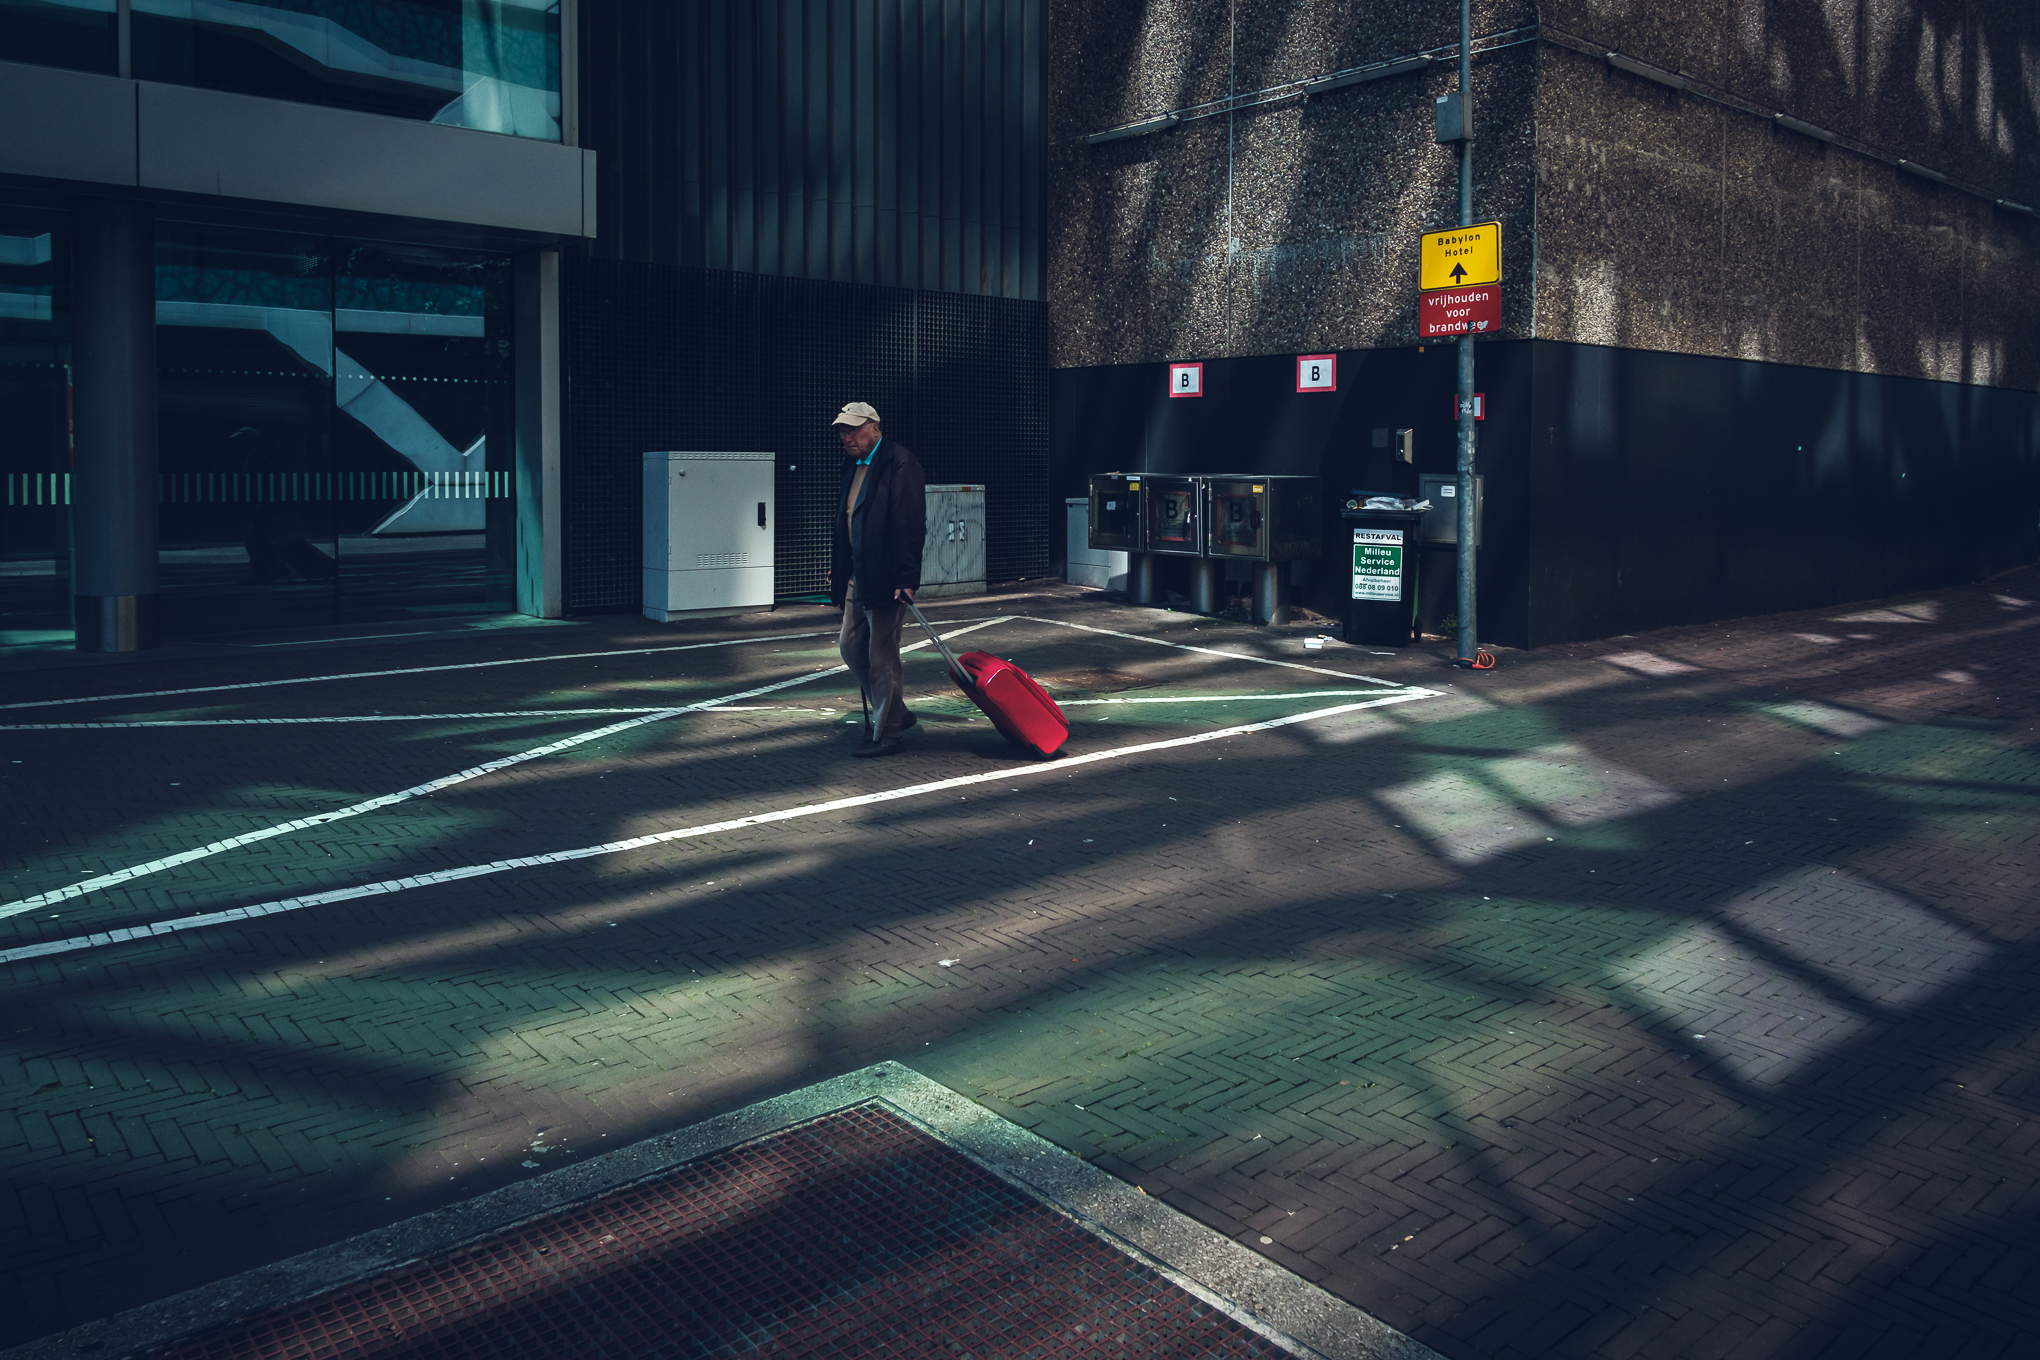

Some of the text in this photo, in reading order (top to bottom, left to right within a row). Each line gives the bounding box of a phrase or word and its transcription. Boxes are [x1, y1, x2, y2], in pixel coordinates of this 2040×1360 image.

[1438, 234, 1480, 246] Babylon
[1445, 246, 1473, 257] Hotel
[1428, 292, 1489, 308] vrijhouden
[1446, 308, 1471, 318] voor
[1311, 366, 1320, 381] B
[1181, 373, 1189, 388] B
[1166, 499, 1178, 519] B
[1230, 502, 1243, 522] B
[1355, 533, 1401, 541] RESTAFVAL
[1364, 547, 1391, 556] Milieu
[1360, 556, 1395, 566] Service
[1355, 566, 1400, 575] Nederland
